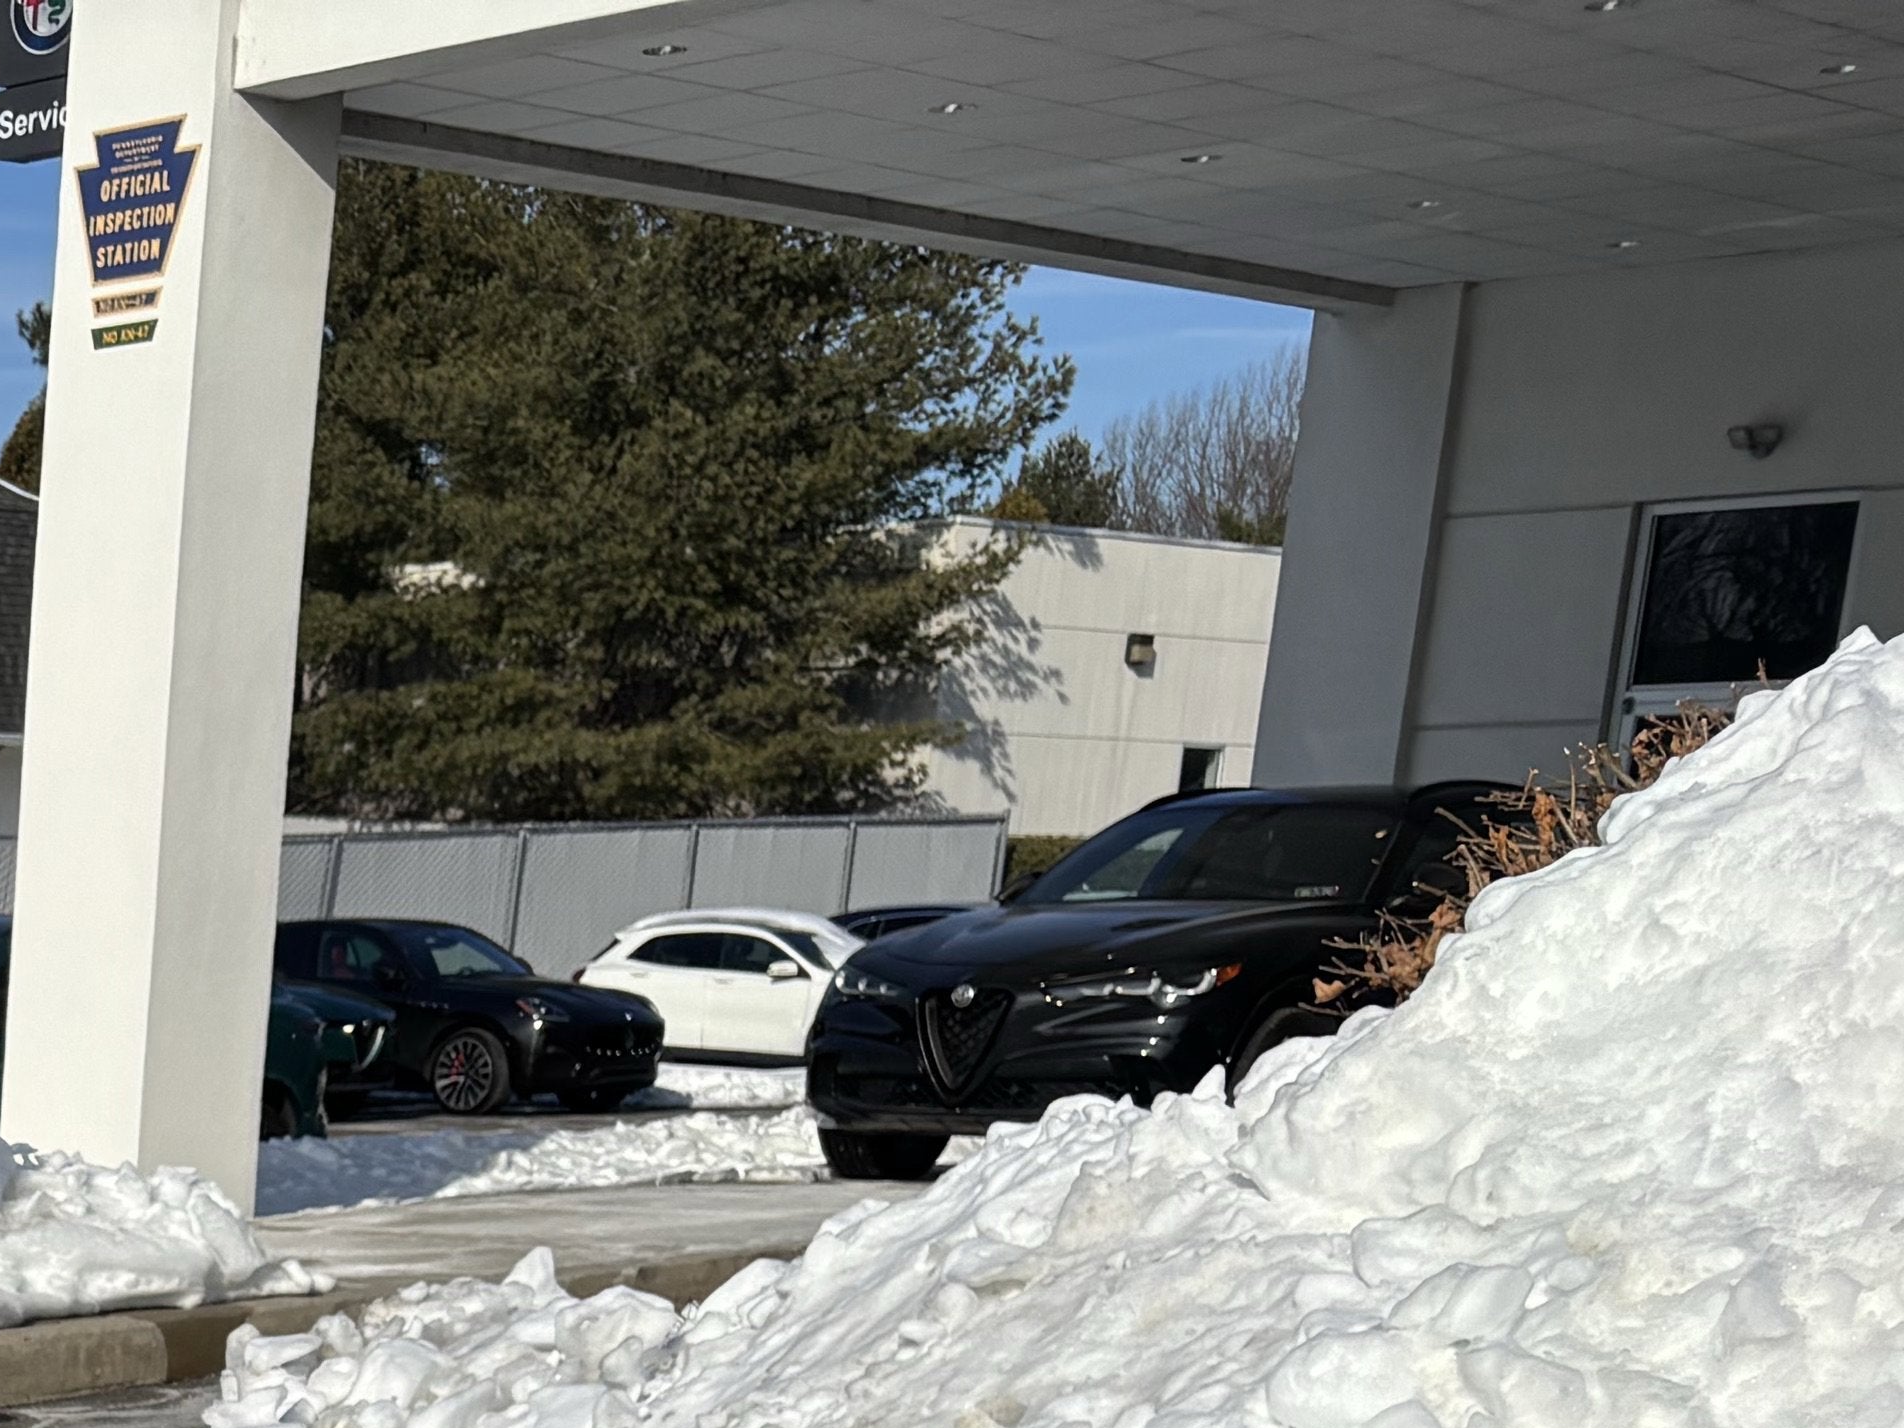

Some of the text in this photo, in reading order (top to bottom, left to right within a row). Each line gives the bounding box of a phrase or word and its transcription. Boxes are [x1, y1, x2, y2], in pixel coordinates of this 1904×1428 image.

[100, 169, 170, 202] OFFICIAL
[89, 202, 176, 237] INSPECTION
[96, 239, 160, 268] STATION
